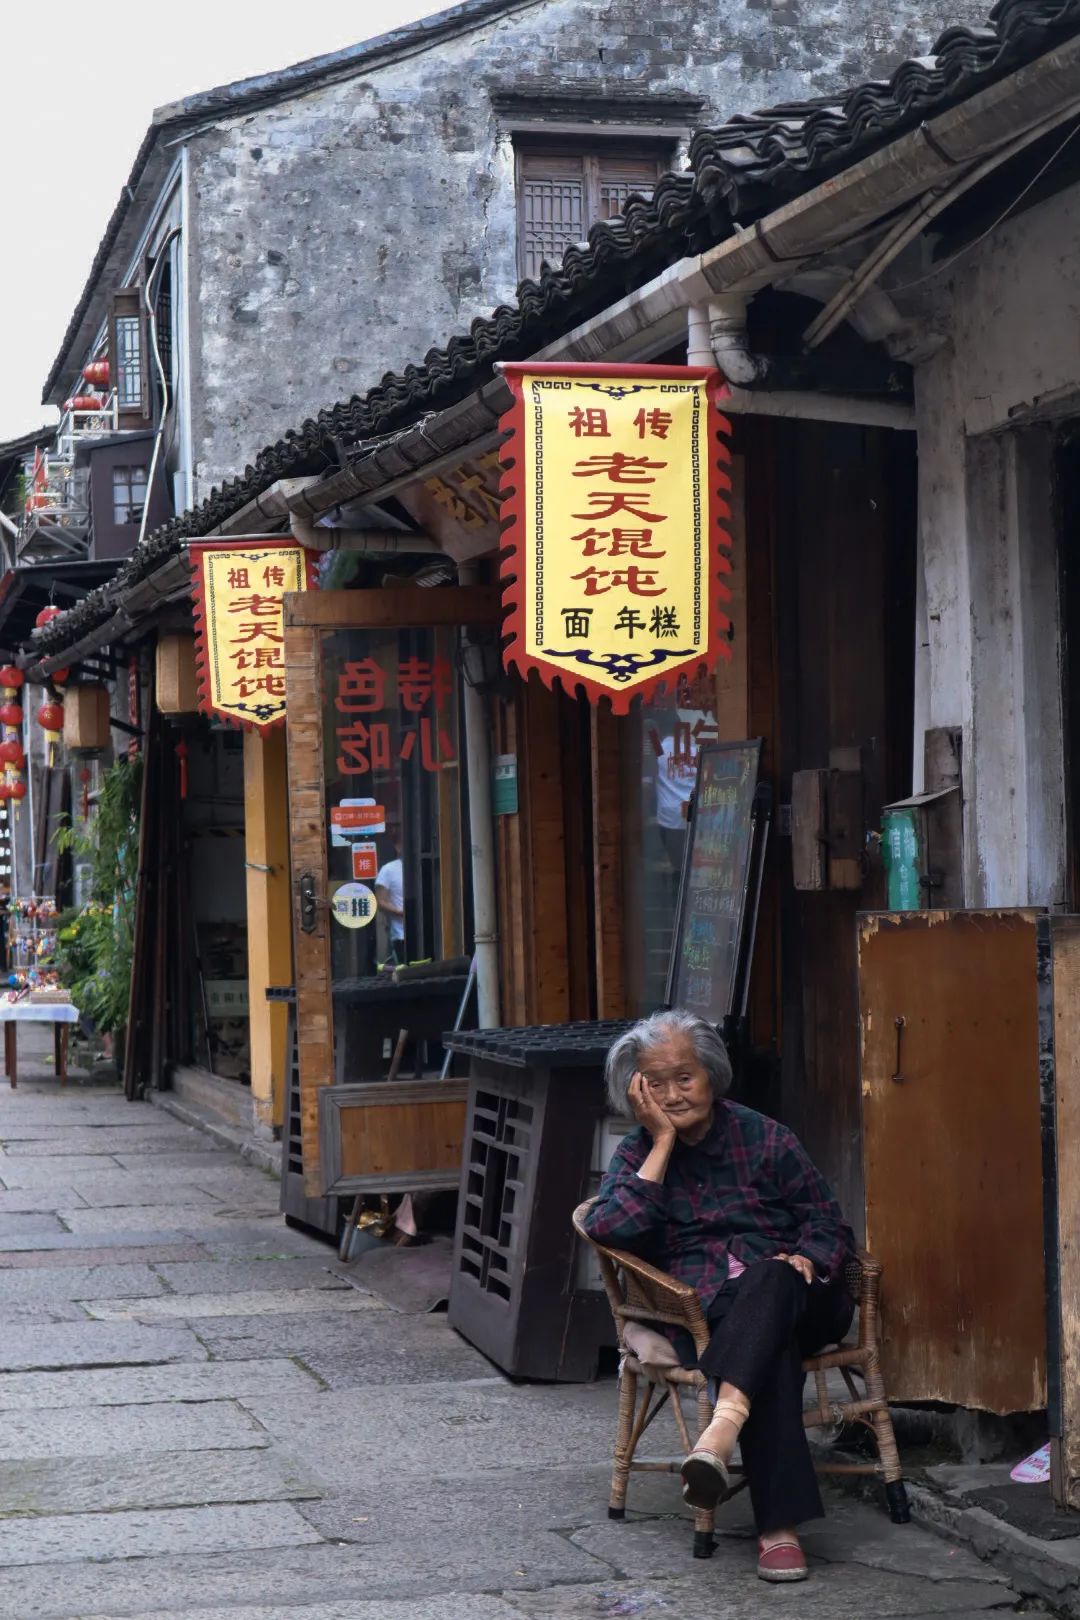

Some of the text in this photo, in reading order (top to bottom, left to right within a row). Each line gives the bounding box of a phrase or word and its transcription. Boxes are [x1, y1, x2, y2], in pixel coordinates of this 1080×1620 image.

[568, 406, 673, 440] 祖传
[570, 452, 669, 597] 老天馄饨
[227, 565, 286, 589] 祖传
[560, 605, 681, 639] 面 年糕
[227, 593, 286, 698] 老天馄饨
